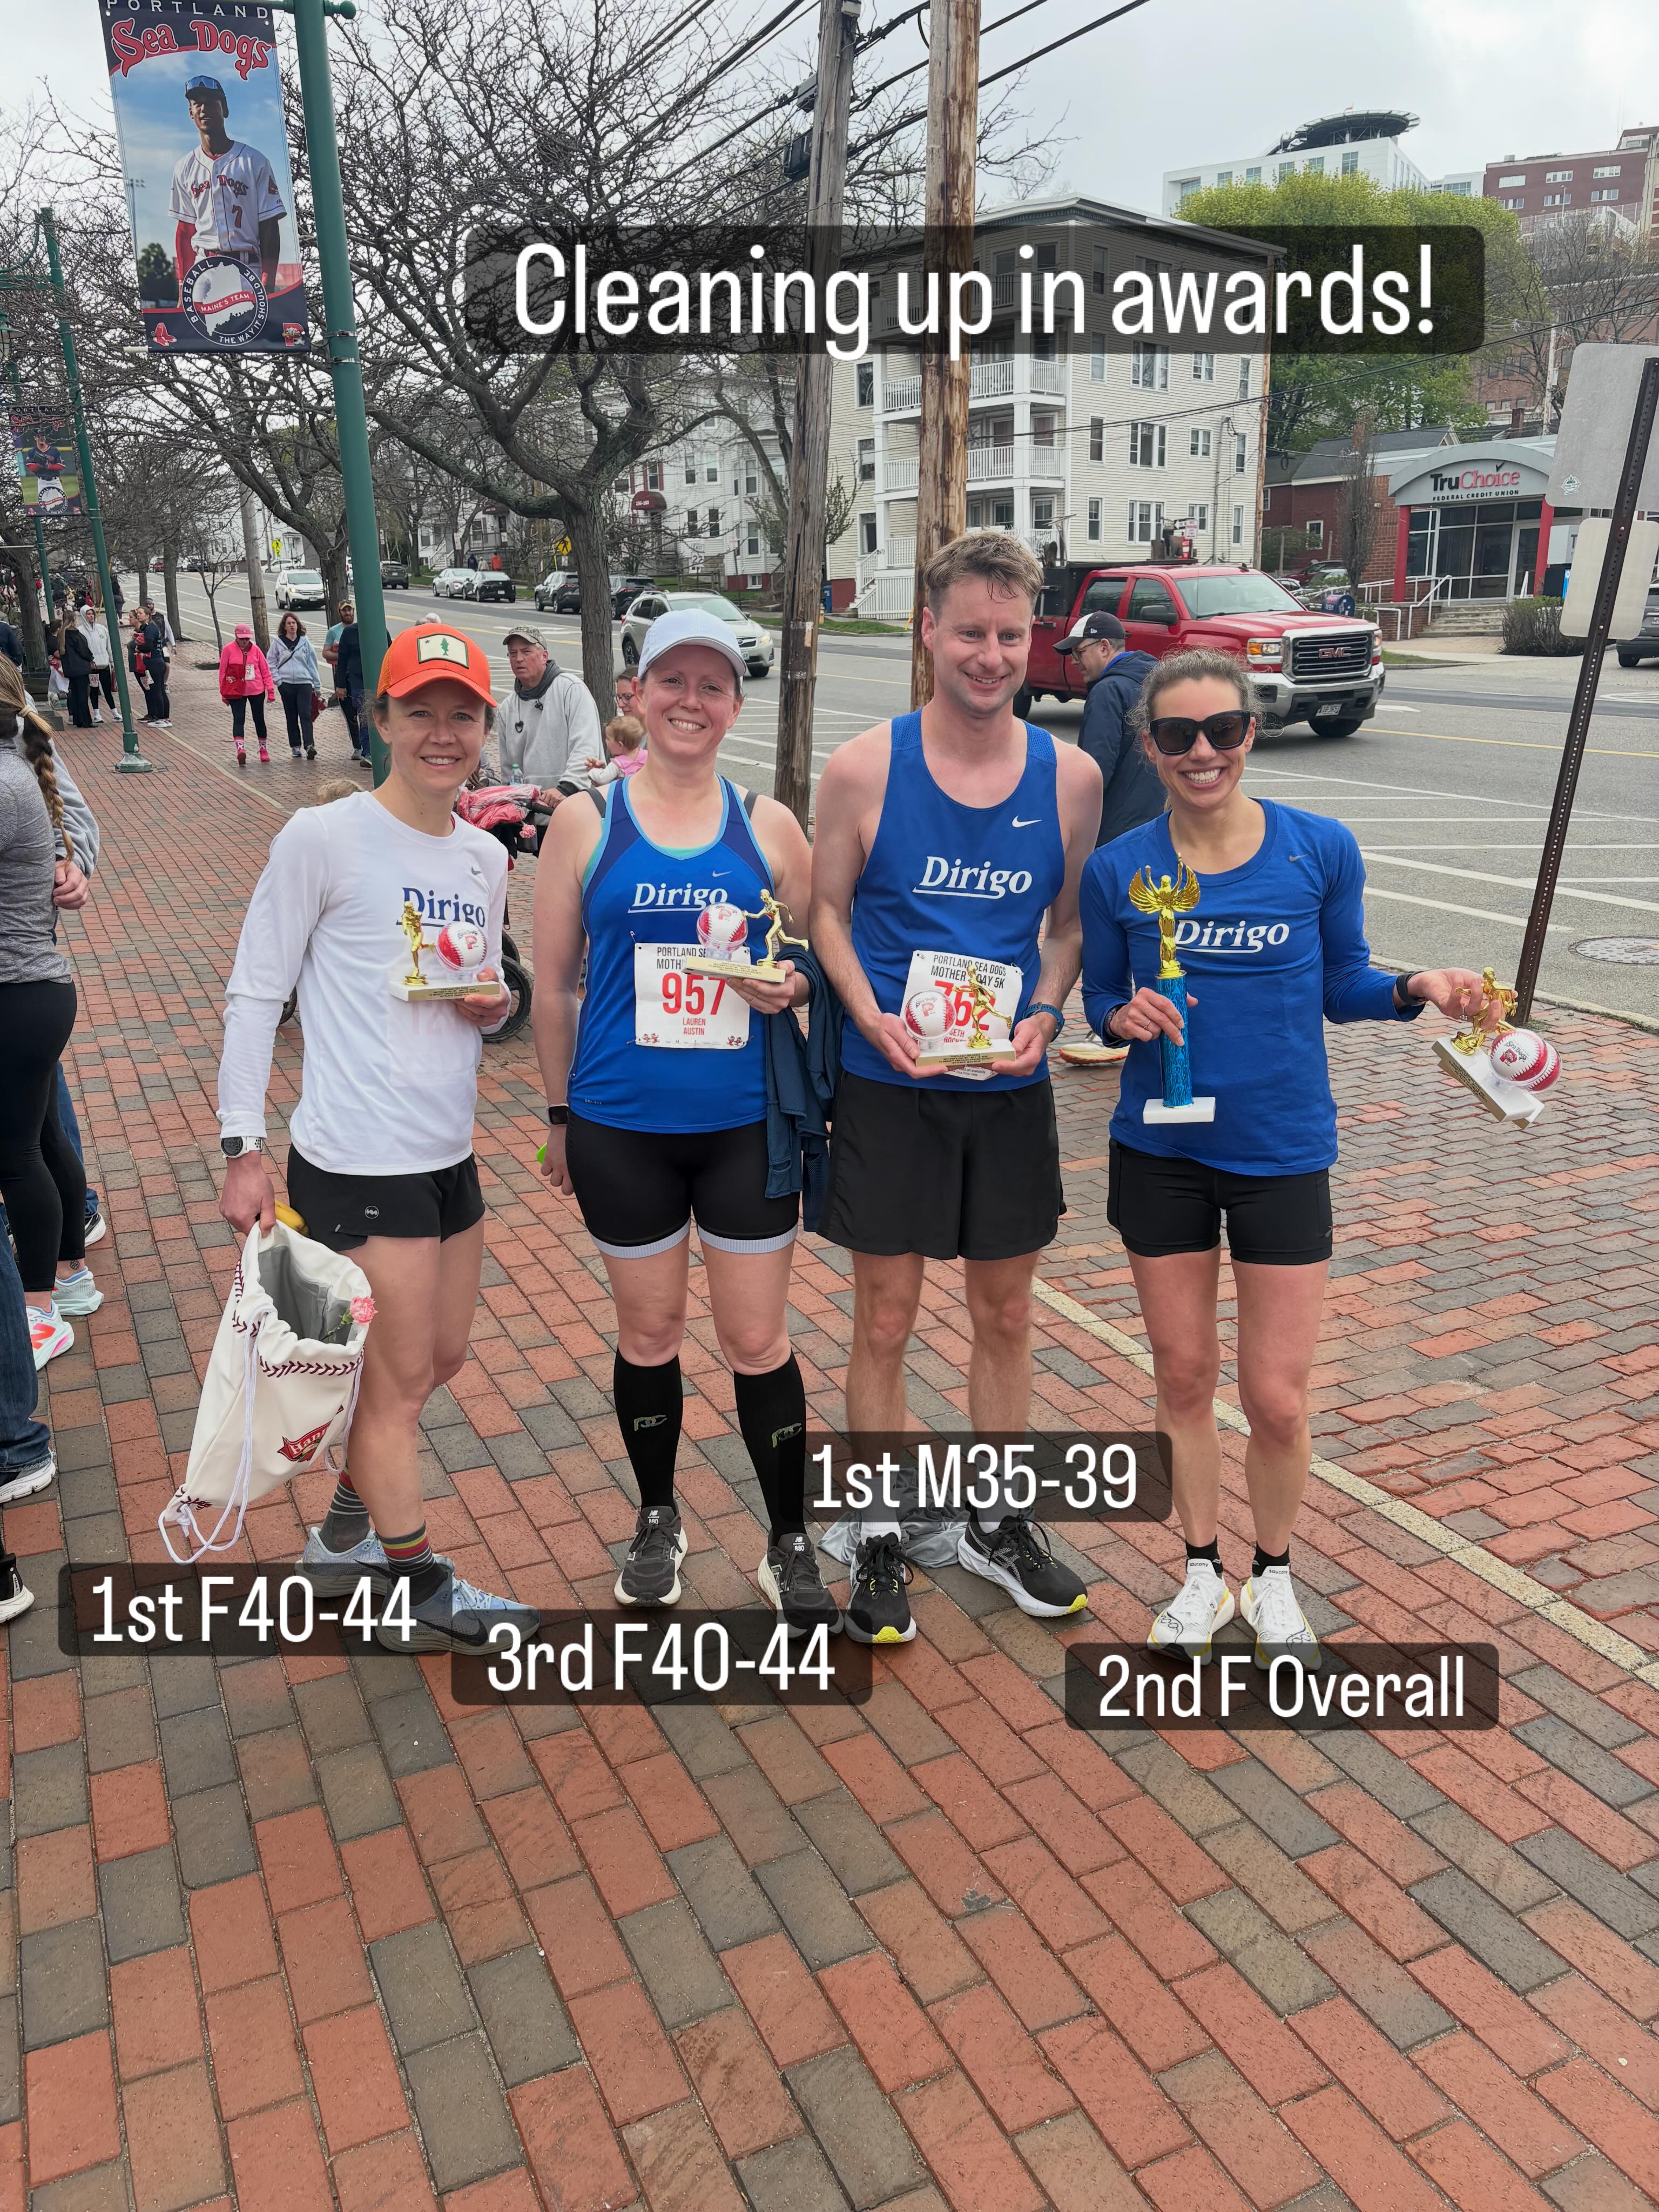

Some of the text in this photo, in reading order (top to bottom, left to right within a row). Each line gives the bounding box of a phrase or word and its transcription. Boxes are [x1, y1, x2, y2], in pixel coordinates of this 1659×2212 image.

[107, 0, 268, 18] PORTLAND
[112, 18, 271, 81] Sea Dogs
[191, 174, 248, 199] Sea Dogs
[231, 205, 243, 228] 7
[184, 260, 214, 323] BASEBALL
[201, 293, 250, 312] MAINE'S TEAM
[219, 269, 265, 343] THE WAY IT SHOULD BE
[1430, 470, 1520, 491] TruChoice
[1319, 647, 1352, 659] GMC
[913, 856, 1033, 899] Dirigo
[402, 887, 485, 928] Dirigo
[628, 882, 728, 913] Dirigo
[1176, 919, 1290, 953] Dirigo
[657, 947, 696, 956] PORTLAND
[933, 954, 1006, 976] PORTLAND SEA DOGS
[977, 974, 993, 986] DAY
[994, 977, 1006, 989] 5K
[662, 973, 726, 1015] 957
[935, 980, 996, 1031] 762
[683, 1018, 706, 1026] LAUREN
[950, 1028, 965, 1037] SETH
